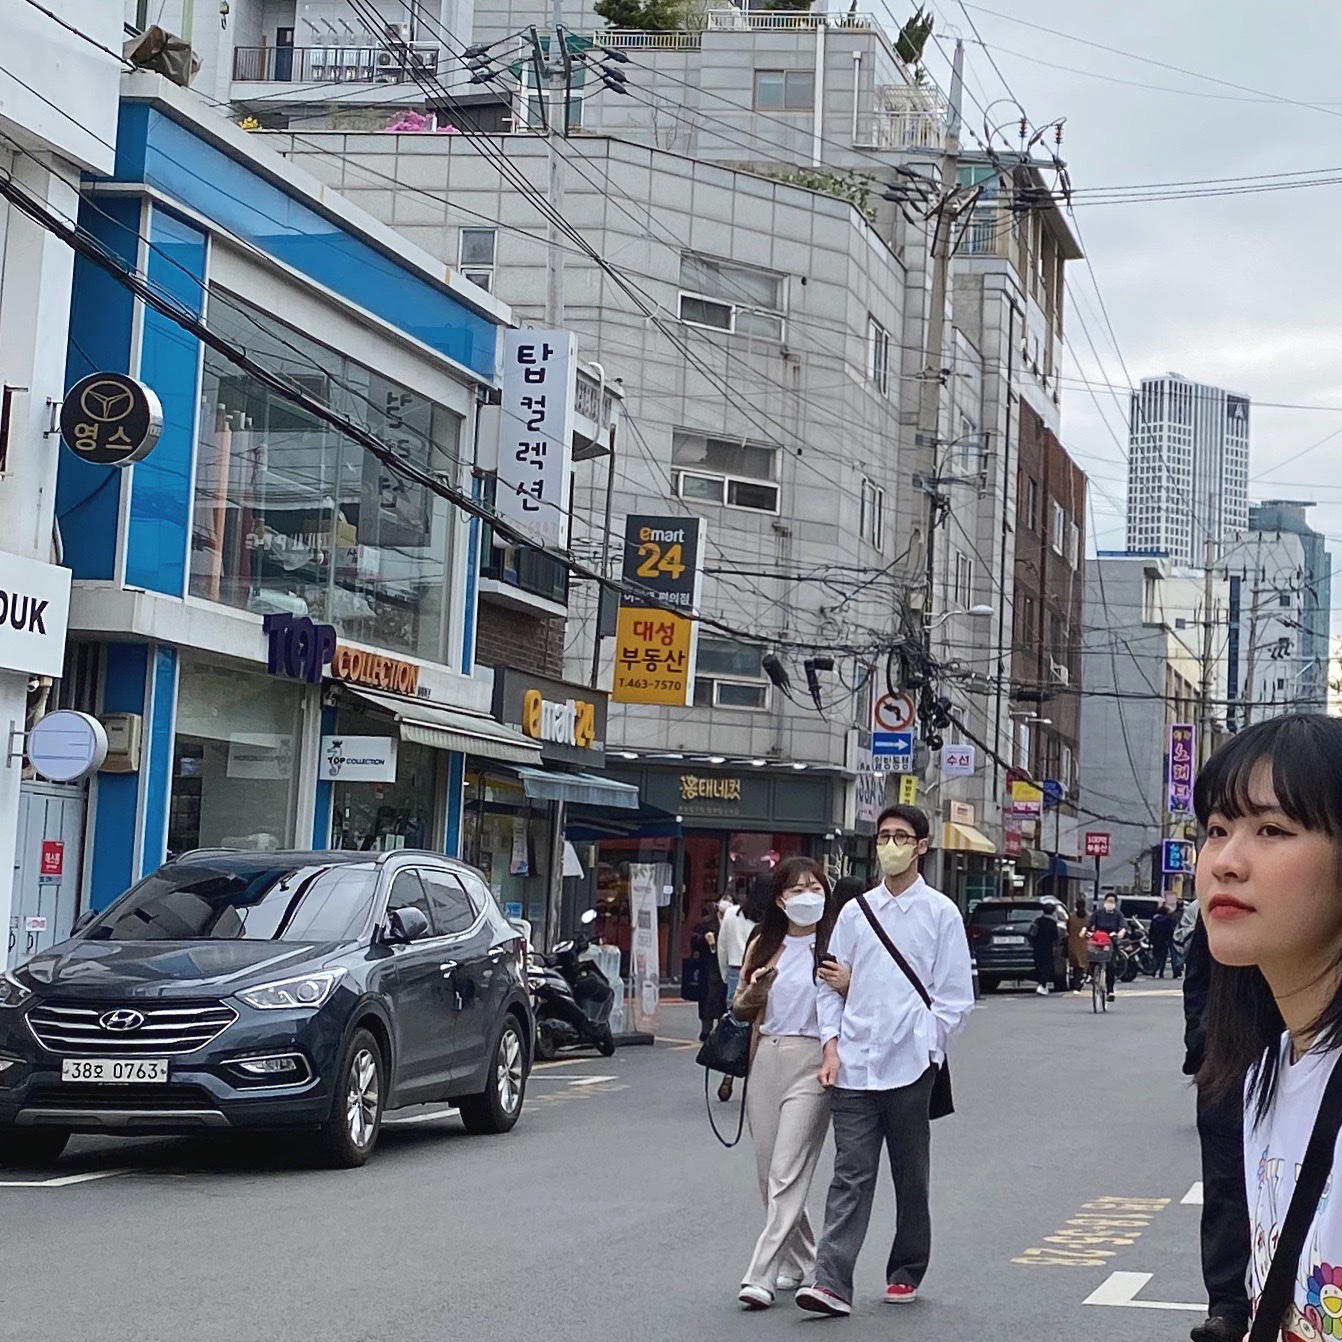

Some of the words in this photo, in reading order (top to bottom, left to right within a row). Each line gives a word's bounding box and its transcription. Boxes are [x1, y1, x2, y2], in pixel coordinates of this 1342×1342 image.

[74, 423, 133, 451] 영스
[515, 343, 554, 511] 탑컬렉션
[639, 527, 685, 543] emart
[637, 543, 686, 580] 24
[633, 621, 675, 646] 대성
[262, 612, 337, 684] TOP
[331, 644, 420, 696] COLLECTION
[619, 647, 686, 673] 부동산
[618, 678, 682, 691] T.463-7570
[346, 757, 385, 766] COLLECTION
[874, 755, 909, 770] 일방통행
[947, 755, 970, 766] 수선
[113, 1063, 158, 1079] 0763
